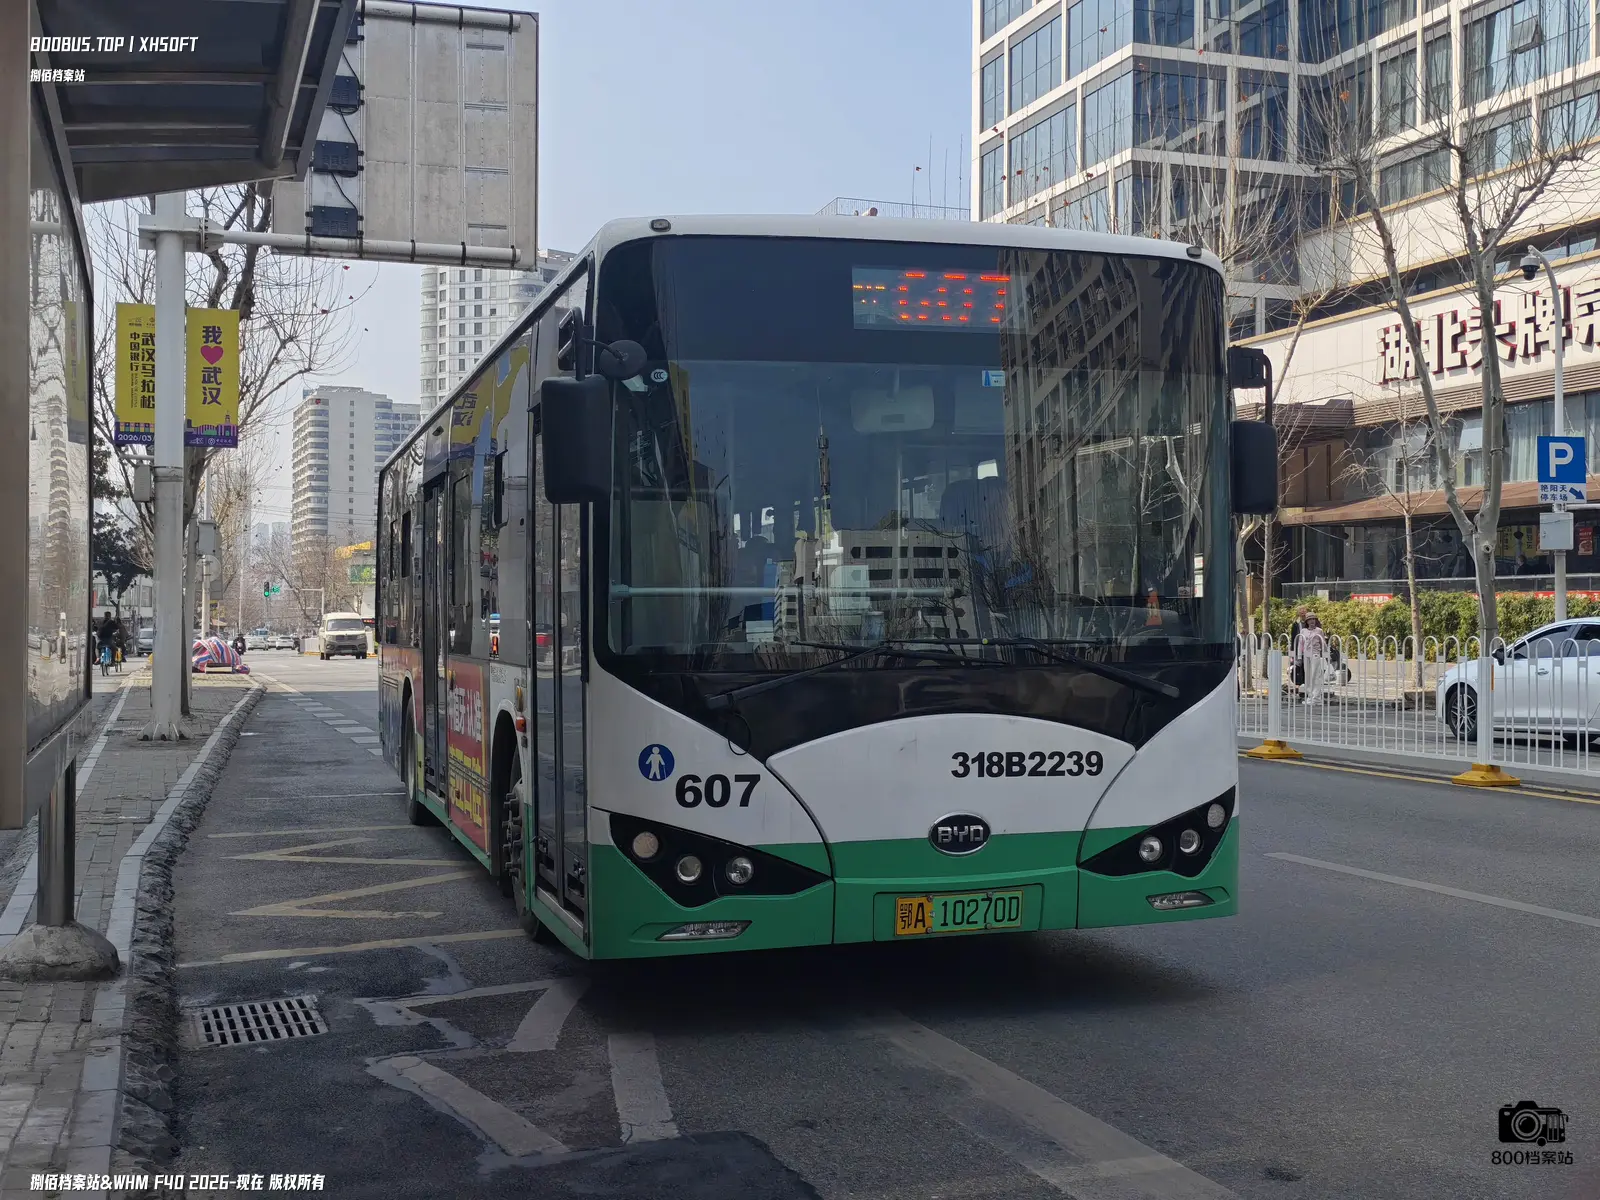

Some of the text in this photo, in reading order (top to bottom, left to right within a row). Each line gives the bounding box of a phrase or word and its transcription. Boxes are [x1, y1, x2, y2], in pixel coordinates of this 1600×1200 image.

[130, 332, 140, 372] 中国银行
[201, 325, 222, 406] 我 武汉
[140, 332, 156, 409] 武汉马拉松
[1549, 442, 1574, 478] P
[1540, 484, 1568, 493] 艳阳天
[1540, 493, 1568, 502] 停车场
[951, 751, 1104, 778] 318B2239
[675, 773, 761, 809] 607
[937, 824, 984, 844] BYD
[900, 896, 1020, 929] 鄂A 10270D
